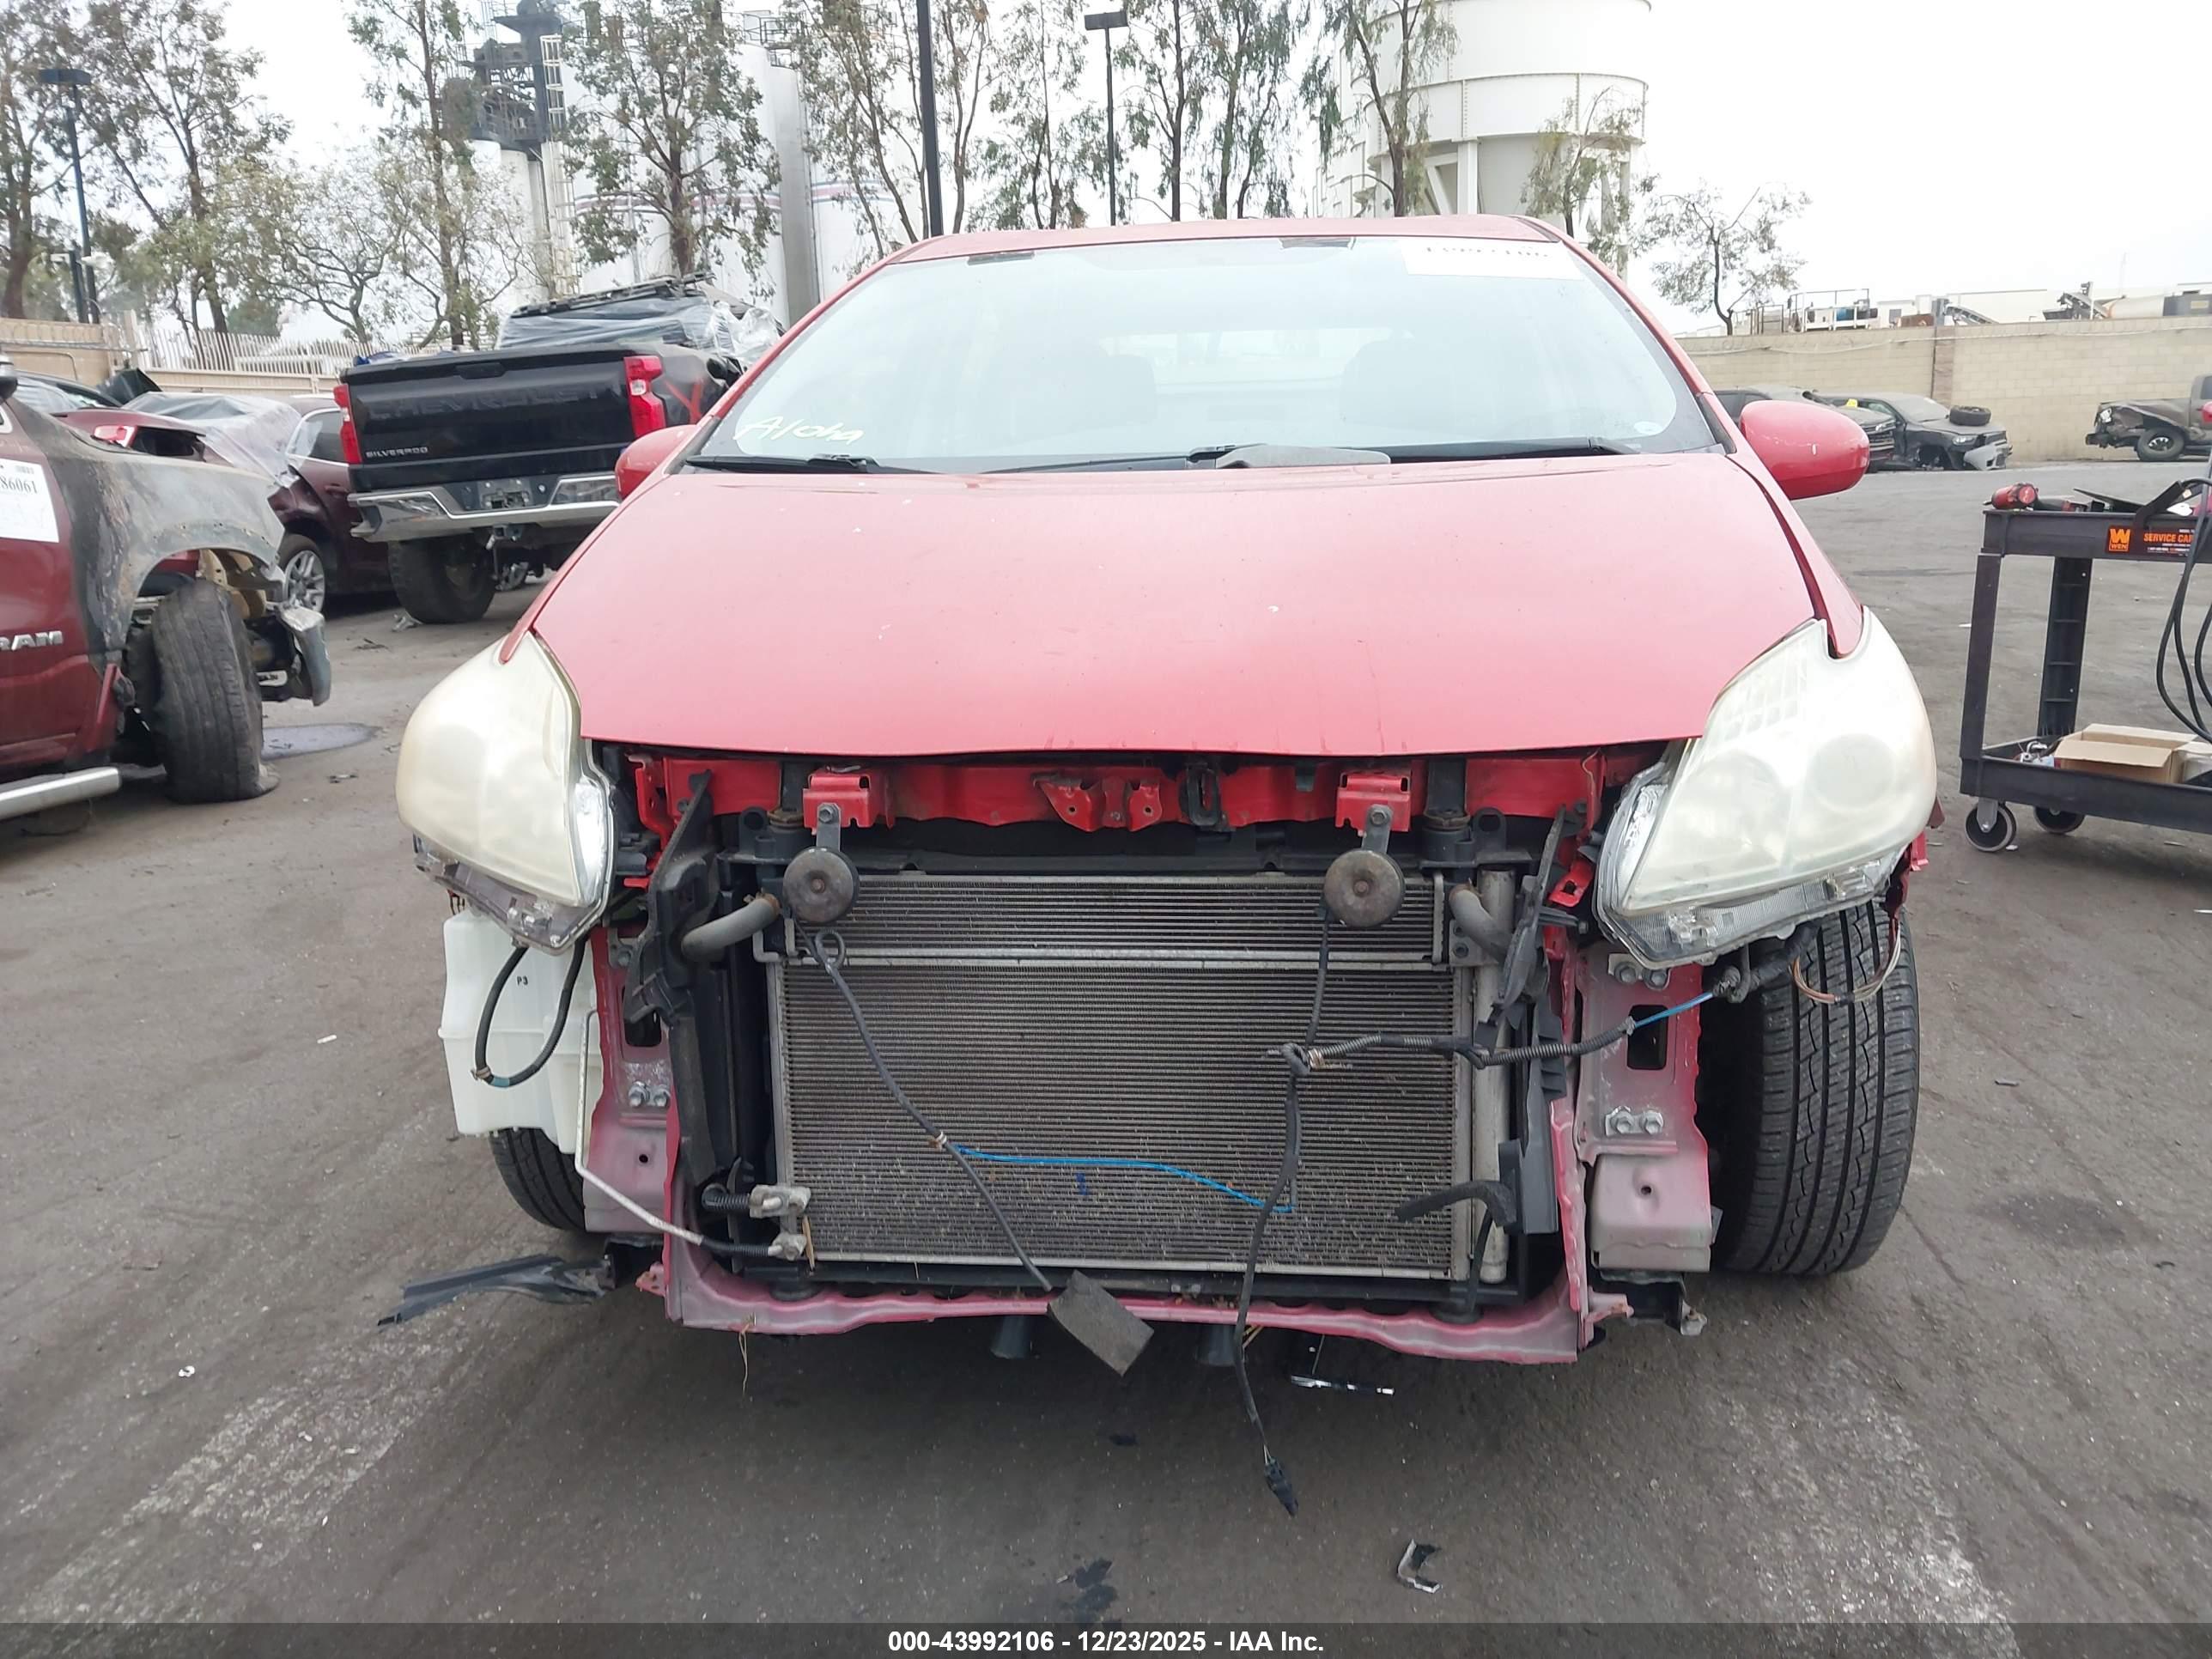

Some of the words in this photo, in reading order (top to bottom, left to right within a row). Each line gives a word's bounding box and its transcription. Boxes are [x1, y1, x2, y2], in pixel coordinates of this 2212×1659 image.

[732, 416, 864, 445] Aloha
[366, 447, 428, 458] SILVERADO
[2110, 528, 2130, 543] W
[2143, 532, 2177, 543] SERVICE
[0, 630, 64, 651] RAM
